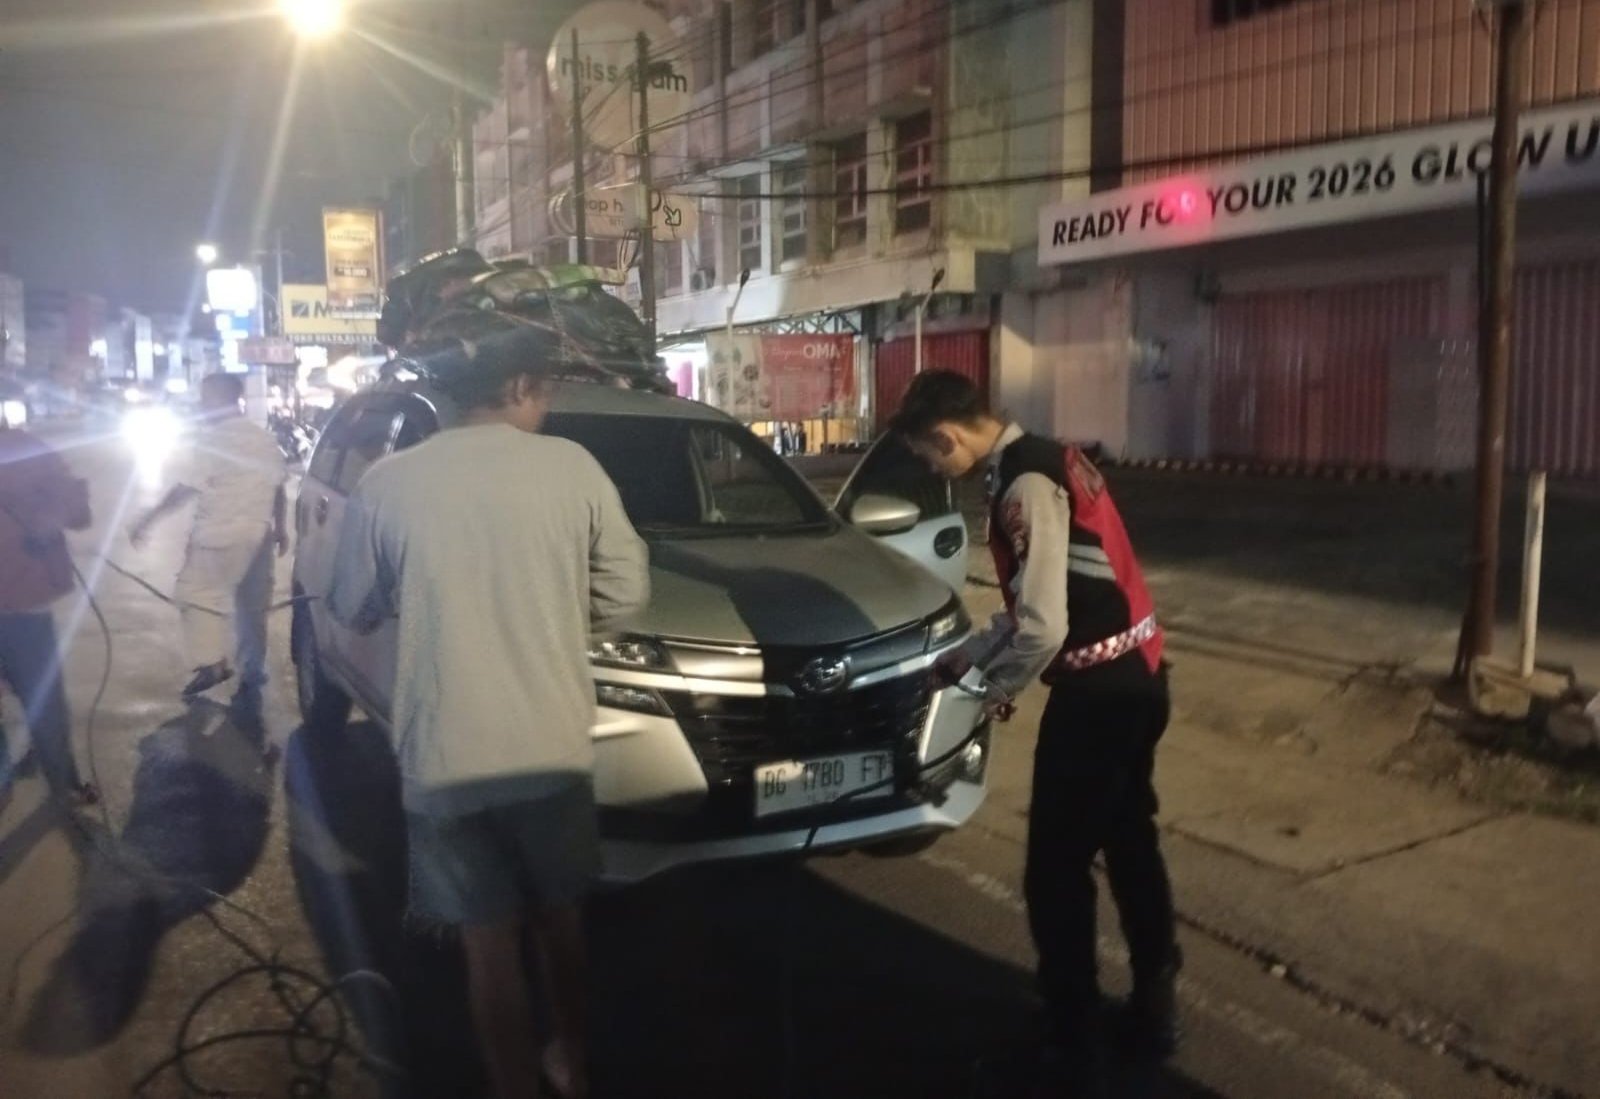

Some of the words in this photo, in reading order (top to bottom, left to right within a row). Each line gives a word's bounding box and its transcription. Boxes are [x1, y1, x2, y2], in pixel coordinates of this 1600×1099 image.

[562, 56, 618, 82] miss
[1053, 205, 1131, 247] READY
[1207, 172, 1297, 219] YOUR
[1308, 152, 1397, 201] 2026
[803, 758, 845, 791] 1780
